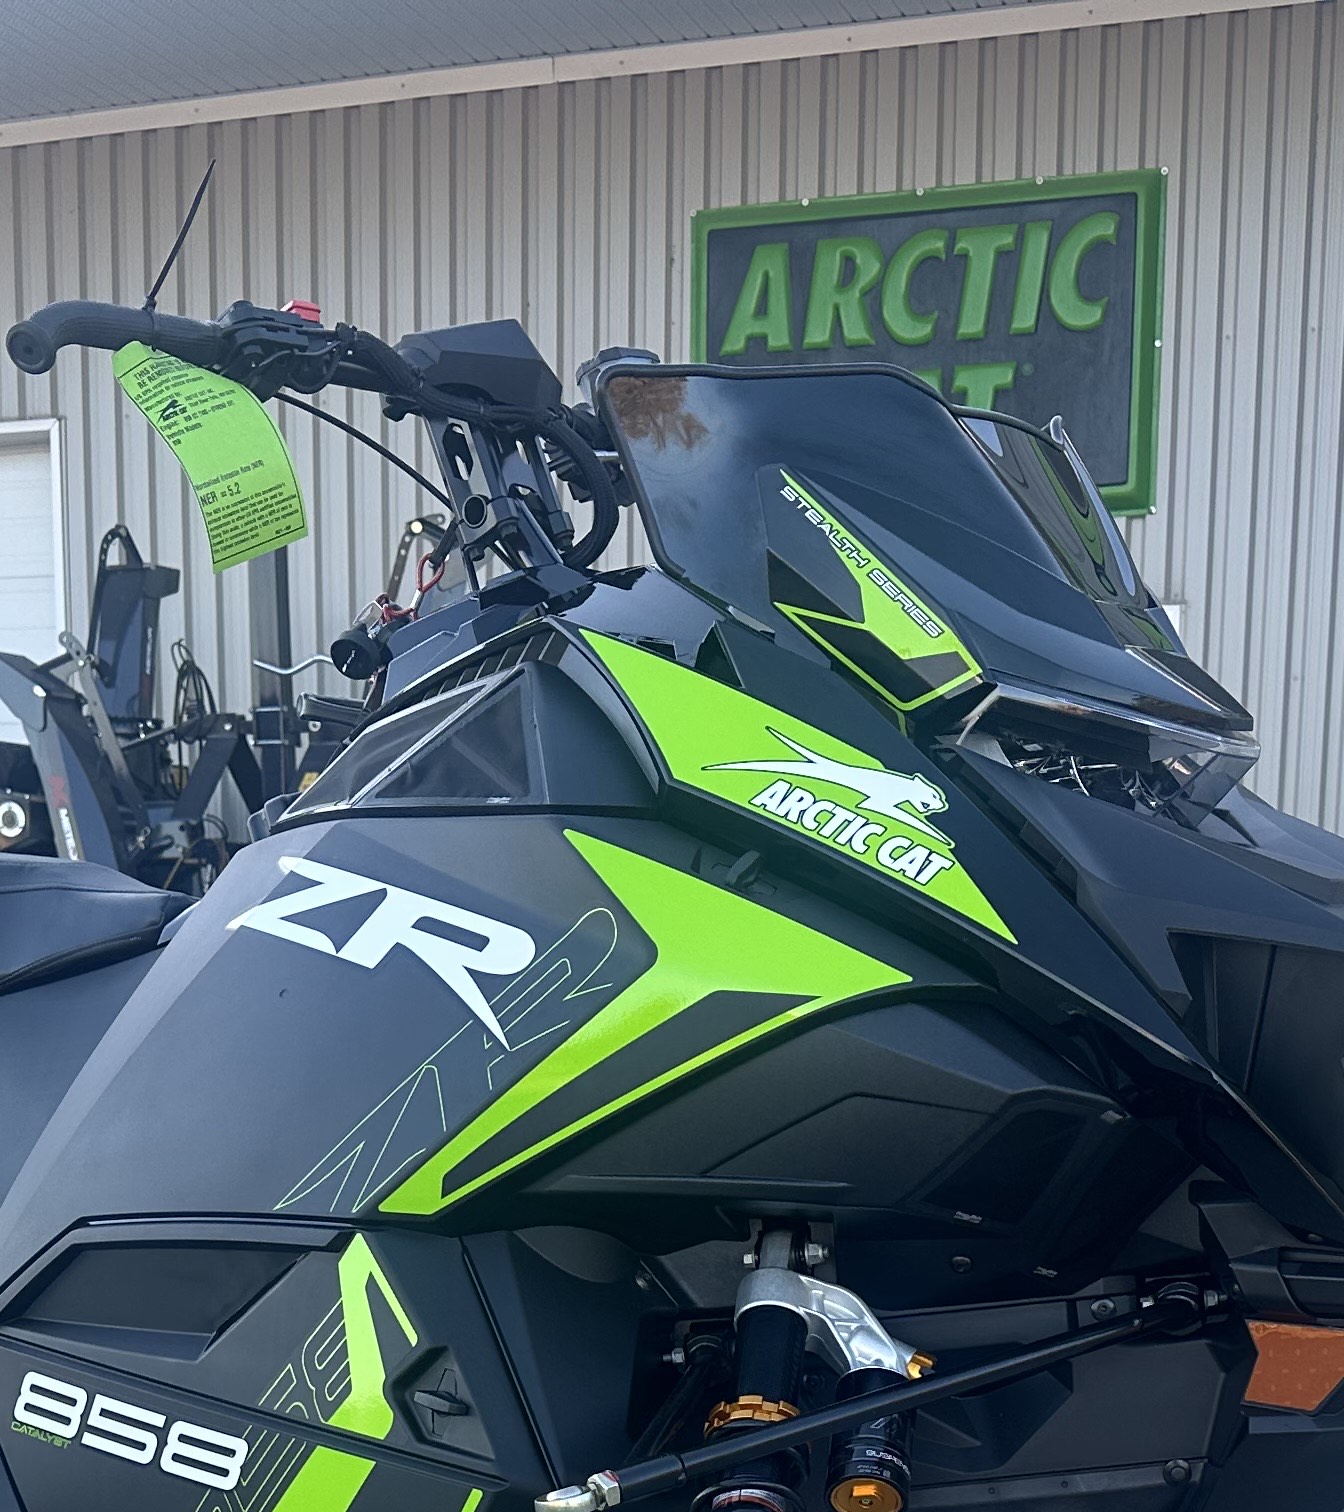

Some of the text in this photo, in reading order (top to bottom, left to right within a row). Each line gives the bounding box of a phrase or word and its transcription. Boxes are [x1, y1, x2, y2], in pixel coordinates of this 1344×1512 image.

[719, 211, 1120, 356] ARCTIC
[200, 491, 218, 507] NER
[227, 482, 241, 497] 5.2
[780, 485, 945, 638] STEALTH SERIES
[748, 778, 955, 886] ARCTIC CAT
[225, 856, 536, 1051] ZR
[10, 1420, 72, 1450] CATALYST
[13, 1371, 249, 1491] 858
